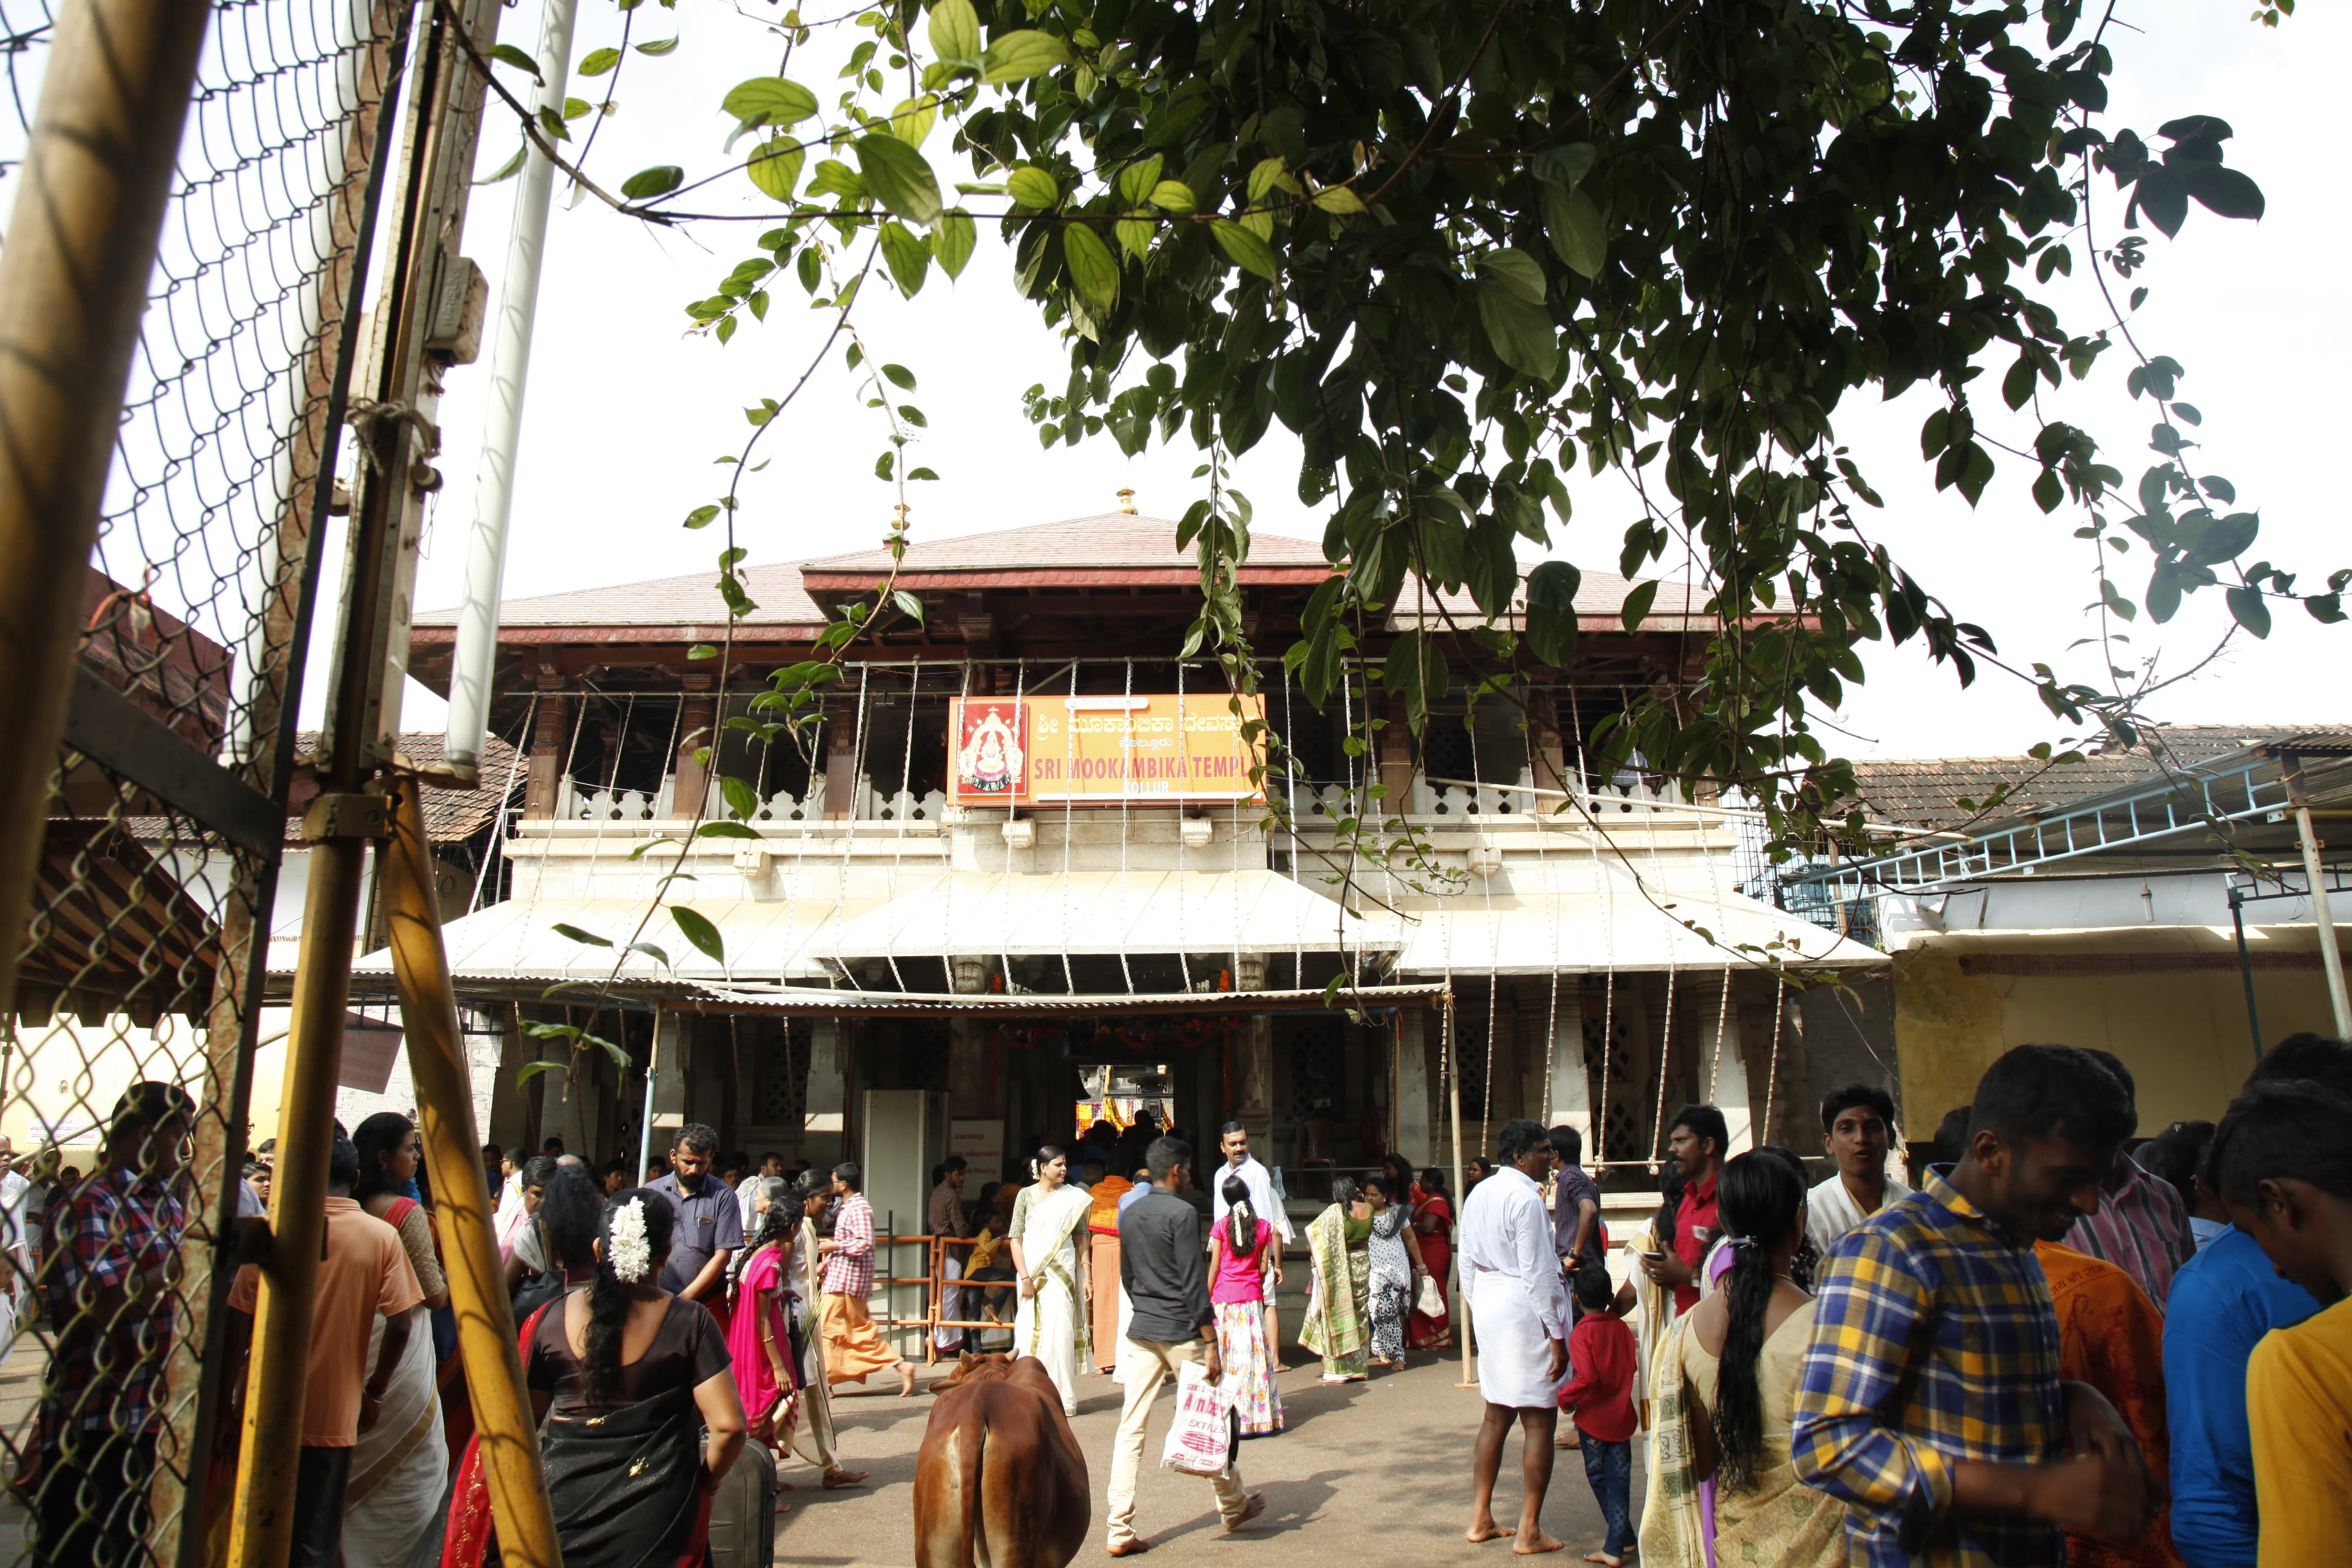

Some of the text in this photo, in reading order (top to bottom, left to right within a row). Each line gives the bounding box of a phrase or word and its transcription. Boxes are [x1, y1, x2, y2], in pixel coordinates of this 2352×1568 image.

[1036, 714, 1058, 742] ಶ್ರೀ
[1034, 758, 1061, 780] SRI
[1067, 756, 1188, 779] MOOKAMBIKA
